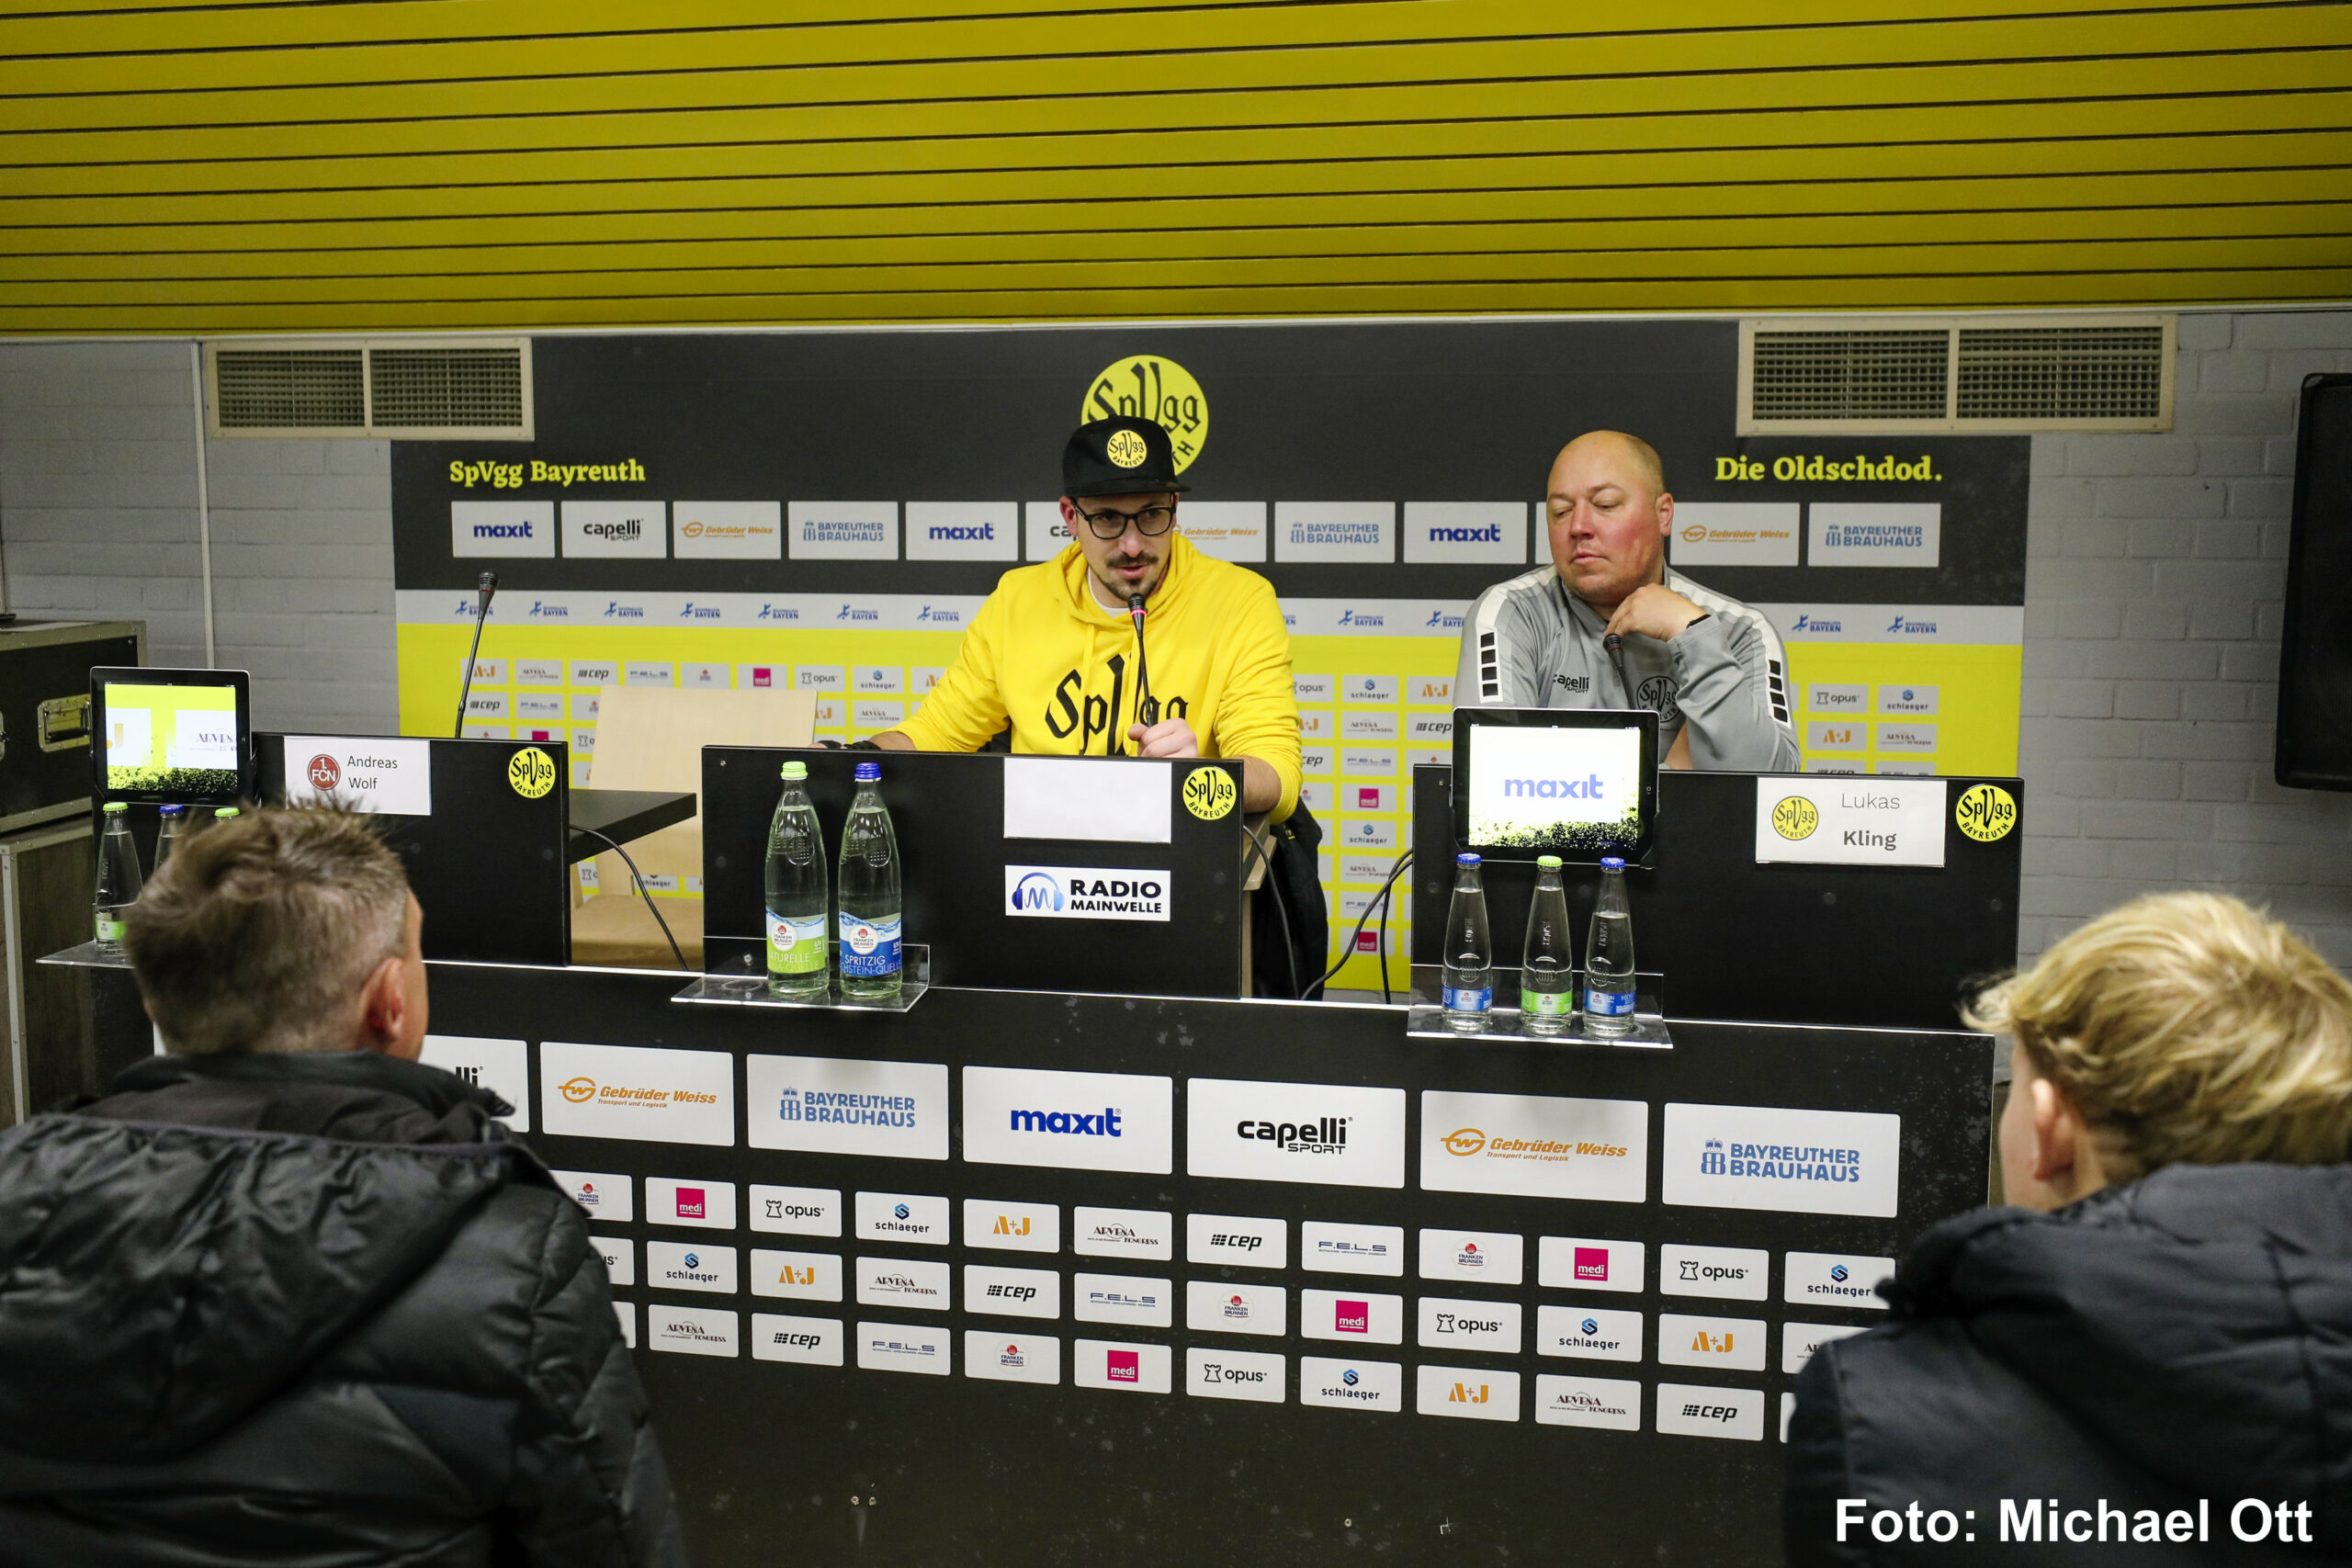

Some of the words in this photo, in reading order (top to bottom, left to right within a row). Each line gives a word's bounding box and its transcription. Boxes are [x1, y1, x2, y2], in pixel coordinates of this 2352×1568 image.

[1108, 433, 1145, 459] SpVgg
[1113, 454, 1144, 467] BAYREUTH
[450, 461, 523, 488] SpVgg
[530, 458, 646, 487] Bayreuth
[1715, 455, 1765, 480] Die
[1773, 456, 1942, 481] Oldschdod.
[474, 522, 533, 537] maxit
[583, 520, 641, 538] capelli
[818, 522, 884, 531] BAYREUTHER
[930, 523, 994, 540] maxit
[1307, 524, 1379, 533] BAYREUTHER
[1430, 524, 1500, 542] maxit
[1844, 525, 1922, 536] BAYREUTHER
[818, 531, 884, 542] BRAUHAUS
[1307, 534, 1379, 544] BRAUHAUS
[1843, 536, 1922, 547] BRAUHAUS
[1905, 626, 1937, 634] BAYERN
[588, 669, 608, 680] cep
[813, 674, 836, 683] opus
[860, 682, 895, 690] schlaeger
[1299, 685, 1323, 694] opus
[1351, 691, 1389, 700] schlaeger
[1830, 694, 1858, 704] opus
[480, 701, 500, 711] cep
[1428, 722, 1452, 734] cep
[320, 759, 327, 770] 1.
[347, 755, 398, 769] Andreas
[511, 751, 551, 786] SpVgg
[312, 770, 336, 782] FCN
[349, 777, 379, 790] Wolf
[514, 781, 551, 797] BAYREUTH
[1185, 770, 1233, 808] SpVgg
[1505, 774, 1603, 799] maxit
[1841, 792, 1900, 810] Lukas
[1189, 801, 1229, 818] BAYREUTH
[1775, 799, 1815, 830] SpVgg
[1959, 788, 2013, 830] SpVgg
[1779, 824, 1812, 838] BAYREUTH
[1962, 821, 2009, 840] BAYREUTH
[1349, 837, 1387, 845] schlaeger
[1843, 830, 1896, 852] Kling
[1070, 879, 1161, 898] RADIO
[1071, 899, 1161, 913] MAINWELLE
[845, 954, 886, 966] SPRITZIG
[600, 1086, 671, 1101] Gebrüder
[673, 1090, 717, 1104] Weiss
[805, 1091, 915, 1111] BAYREUTHER
[597, 1099, 627, 1107] Transport
[642, 1100, 667, 1109] Logistik
[805, 1106, 915, 1128] BRAUHAUS
[1011, 1108, 1121, 1137] maxit
[1237, 1117, 1347, 1148] capelli
[1288, 1143, 1346, 1155] SPORT
[1490, 1137, 1573, 1154] Gebrüder
[1577, 1142, 1628, 1157] Weiss
[1731, 1143, 1860, 1165] BAYREUTHER
[1731, 1159, 1860, 1182] BRAUHAUS
[680, 1203, 702, 1213] medi
[785, 1205, 820, 1219] opus
[875, 1221, 930, 1235] schlaeger
[992, 1216, 1031, 1235] A+J
[1227, 1235, 1262, 1251] cep
[667, 1269, 718, 1282] schlaeger
[779, 1266, 814, 1285] A+J
[1577, 1264, 1604, 1275] medi
[1702, 1266, 1744, 1281] opus
[1003, 1286, 1036, 1302] cep
[1807, 1284, 1871, 1297] schlaeger
[1340, 1317, 1364, 1326] medi
[1458, 1319, 1498, 1334] opus
[789, 1334, 820, 1349] cep
[1558, 1337, 1620, 1350] schlaeger
[1691, 1332, 1734, 1352] A+J
[1110, 1365, 1136, 1376] medi
[1225, 1369, 1263, 1383] opus
[1321, 1387, 1380, 1400] schlaeger
[1448, 1383, 1488, 1404] A+J
[1556, 1394, 1601, 1405] ARVENA
[1701, 1405, 1738, 1423] cep
